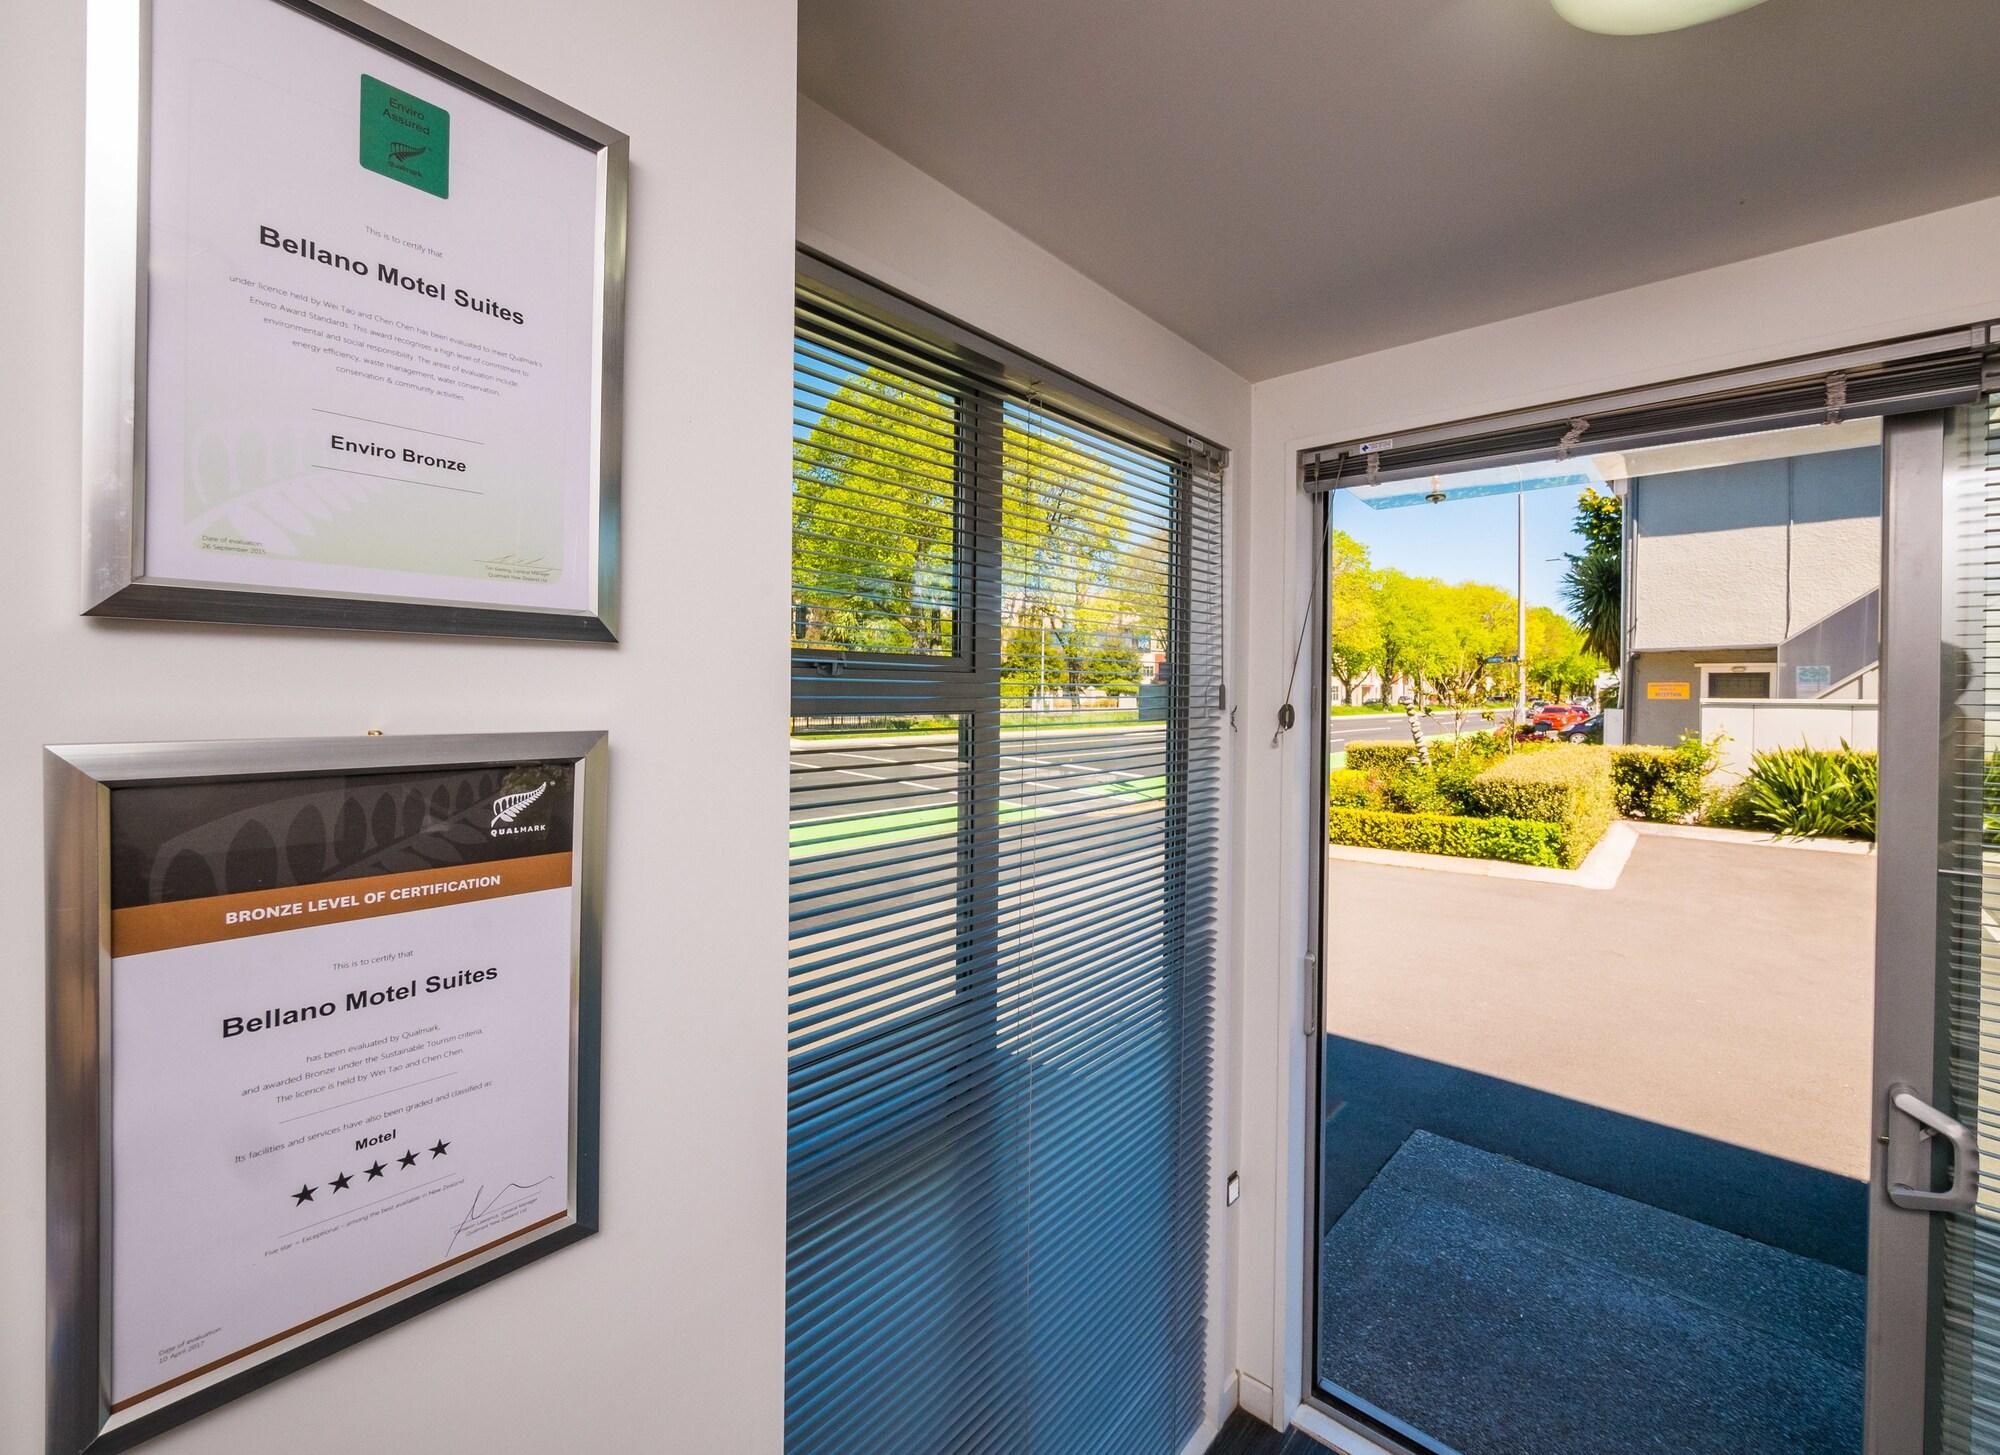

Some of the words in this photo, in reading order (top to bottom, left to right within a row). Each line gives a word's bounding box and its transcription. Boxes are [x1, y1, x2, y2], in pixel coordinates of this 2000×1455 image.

[382, 108, 431, 135] Assured
[389, 97, 425, 120] Enviro
[366, 226, 381, 238] This
[391, 235, 401, 244] to
[402, 240, 426, 254] certify
[427, 247, 443, 258] that
[260, 225, 369, 276] Bellano
[378, 263, 446, 301] Motel
[454, 289, 524, 325] Suites
[229, 276, 256, 287] under
[258, 282, 288, 297] licence
[290, 291, 309, 302] held
[310, 297, 321, 307] by
[323, 300, 339, 310] Wei
[341, 305, 356, 316] Tao
[357, 311, 373, 320] and
[374, 315, 394, 326] Chen
[395, 321, 415, 332] Chen
[416, 327, 429, 336] has
[430, 330, 448, 341] been
[449, 337, 482, 351] evaluated
[249, 296, 278, 310] Enviro
[279, 304, 307, 318] Award
[353, 323, 368, 334] This
[370, 330, 393, 340] award
[394, 336, 432, 352] recognises
[440, 348, 456, 358] high
[456, 352, 472, 361] level
[481, 360, 521, 375] commitment
[263, 317, 324, 337] environmental
[326, 333, 341, 342] and
[343, 337, 364, 348] social
[418, 356, 431, 364] The
[432, 361, 450, 370] areas
[460, 368, 494, 380] evaluation
[496, 378, 518, 387] include
[292, 341, 321, 353] energy
[363, 358, 384, 368] waste
[437, 377, 456, 385] water
[336, 366, 385, 382] conservation
[394, 380, 434, 395] community
[331, 434, 396, 459] Enviro
[402, 448, 466, 472] Bronze
[490, 824, 546, 838] QUALMARK
[225, 903, 303, 925] BRONZE
[308, 895, 360, 913] LEVEL
[364, 891, 386, 904] OF
[390, 875, 501, 901] CERTIFICATION
[333, 962, 349, 971] This
[360, 959, 370, 967] to
[371, 953, 396, 965] certify
[397, 950, 414, 960] that
[222, 1002, 337, 1039] Bellano
[345, 980, 417, 1012] Motel
[425, 967, 498, 994] Suites
[241, 1085, 260, 1097] and
[262, 1074, 302, 1091] awarded
[304, 1067, 336, 1080] Bronze
[338, 1060, 362, 1071] under
[365, 1056, 378, 1064] the
[380, 1044, 425, 1060] Sustainable
[427, 1036, 456, 1048] Tourism
[306, 1054, 322, 1064] has
[324, 1048, 346, 1059] been
[348, 1036, 388, 1053] evaluated
[276, 1095, 293, 1104] The
[295, 1086, 326, 1098] licence
[336, 1076, 355, 1087] held
[370, 1070, 386, 1078] Wei
[388, 1065, 403, 1073] Tao
[405, 1059, 420, 1069] and
[422, 1054, 442, 1064] Chen
[443, 1048, 464, 1058] Chen
[235, 1156, 246, 1164] Its
[249, 1144, 285, 1159] facilities
[288, 1136, 305, 1148] and
[307, 1127, 341, 1142] services
[343, 1120, 363, 1130] have
[365, 1114, 382, 1124] also
[383, 1108, 404, 1118] been
[406, 1097, 434, 1112] graded
[435, 1092, 450, 1103] and
[451, 1082, 483, 1098] classified
[355, 1128, 397, 1152] Motel
